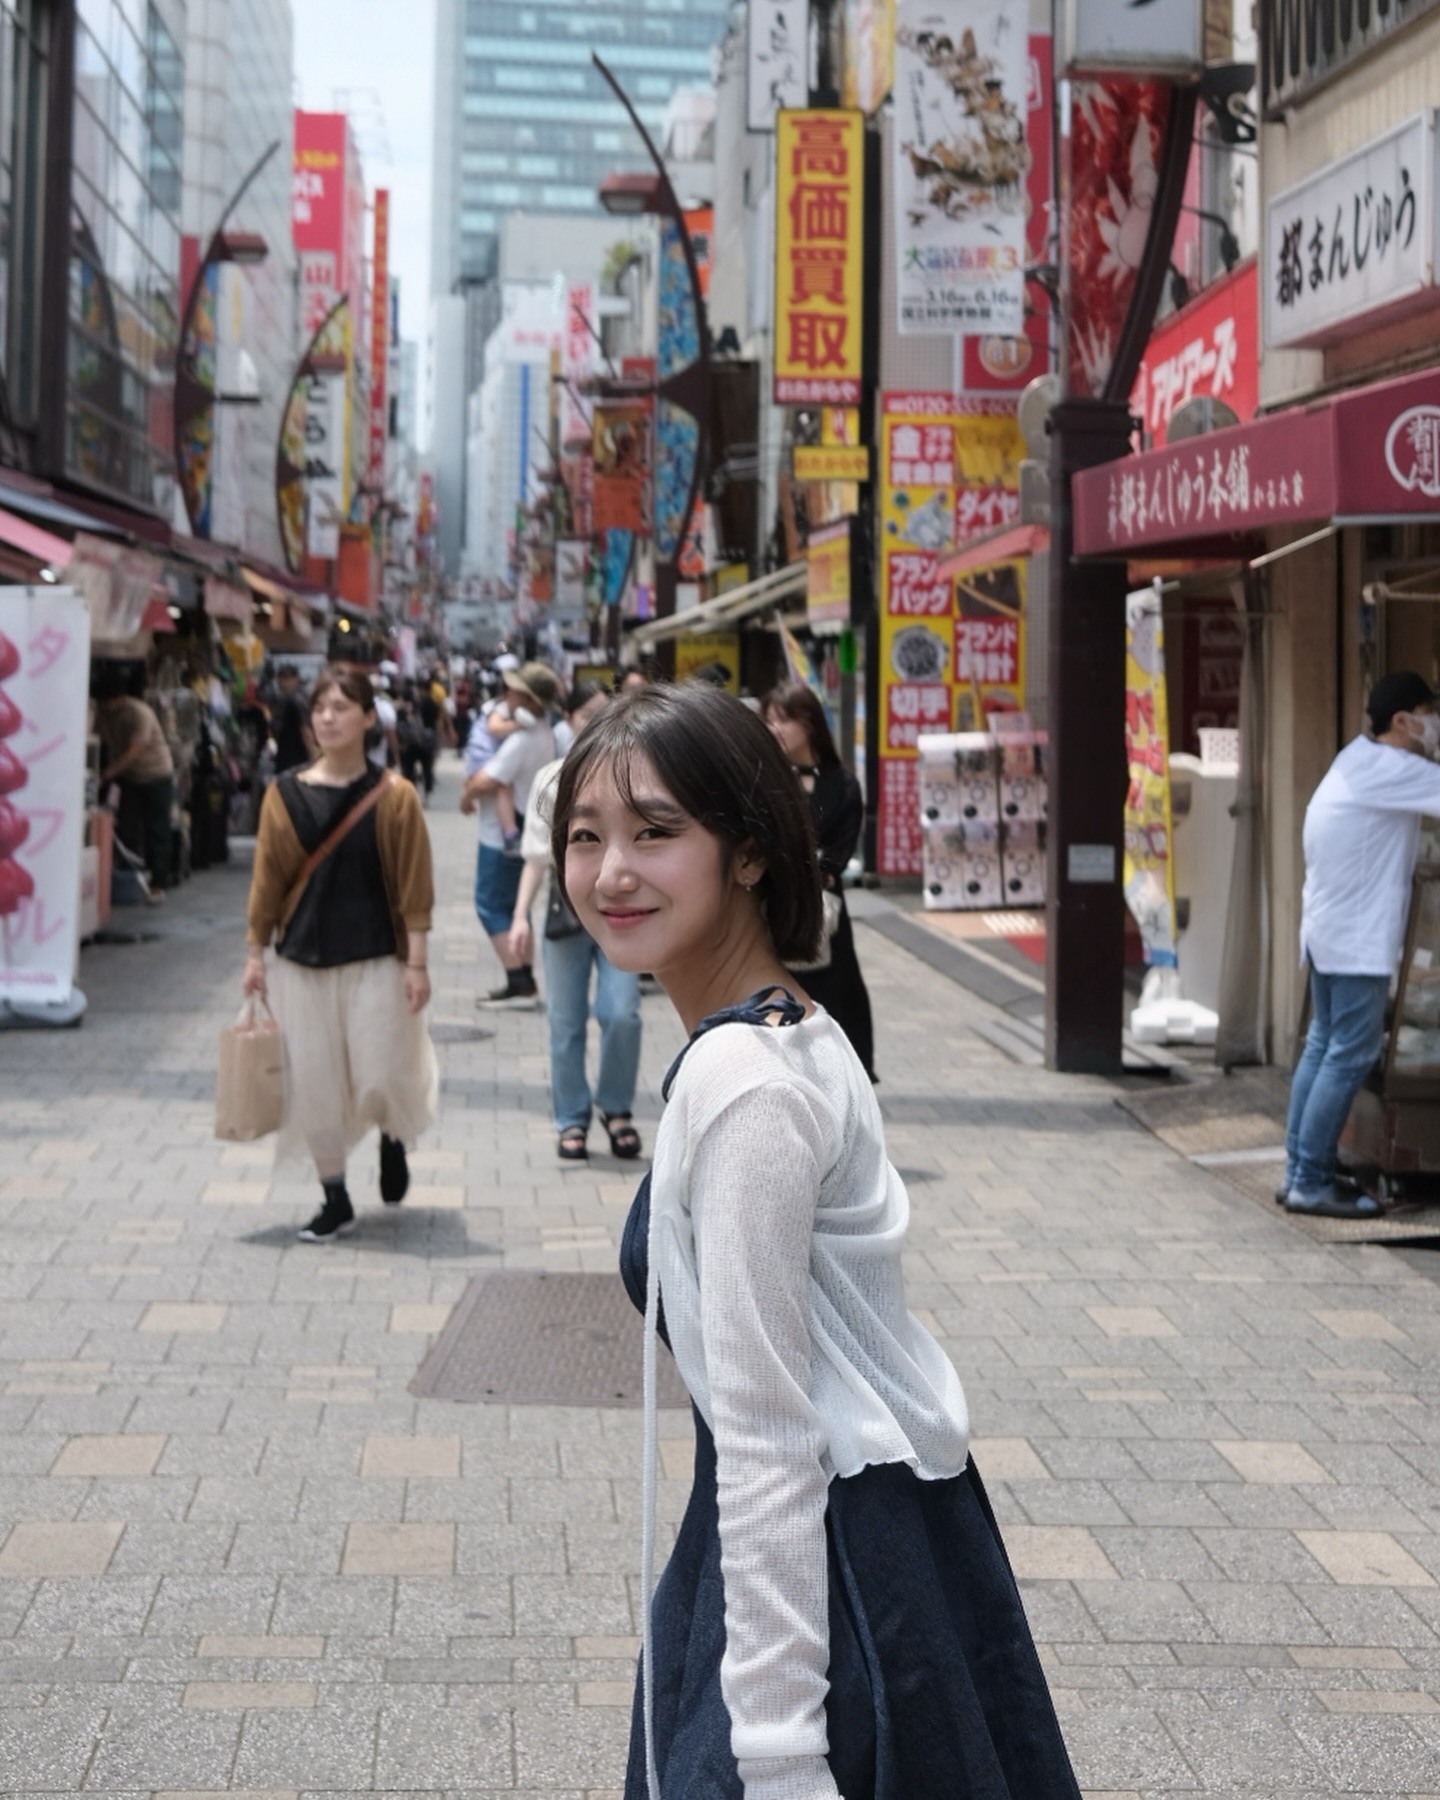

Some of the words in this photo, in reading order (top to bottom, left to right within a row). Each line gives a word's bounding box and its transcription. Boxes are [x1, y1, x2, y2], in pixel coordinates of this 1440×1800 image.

[788, 117, 850, 369] 高価買取
[1276, 167, 1416, 307] 都まんじゅう
[890, 585, 949, 614] バッグ
[891, 686, 949, 719] 切手
